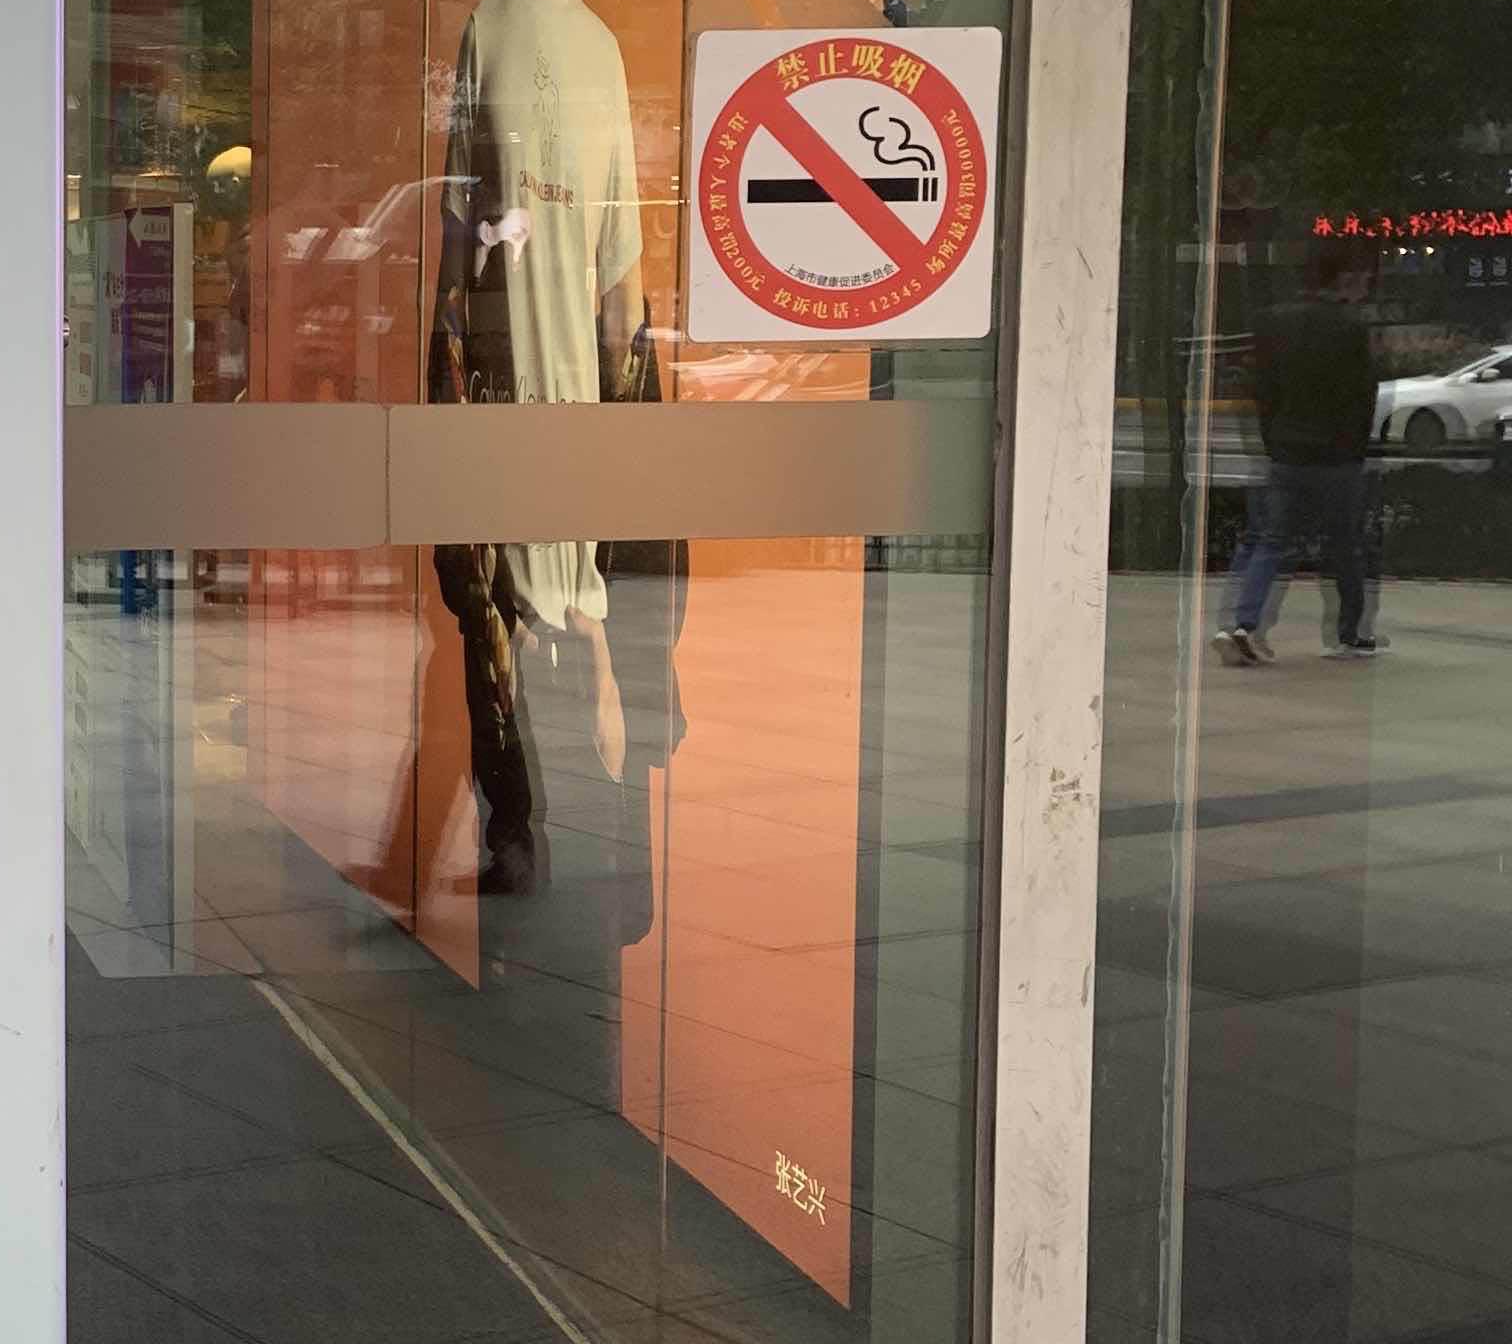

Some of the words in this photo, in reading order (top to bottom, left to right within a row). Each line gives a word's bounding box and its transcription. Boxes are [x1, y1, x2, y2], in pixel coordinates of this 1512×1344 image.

[776, 43, 927, 96] 禁止吸烟
[775, 1149, 826, 1226] 张艺兴
